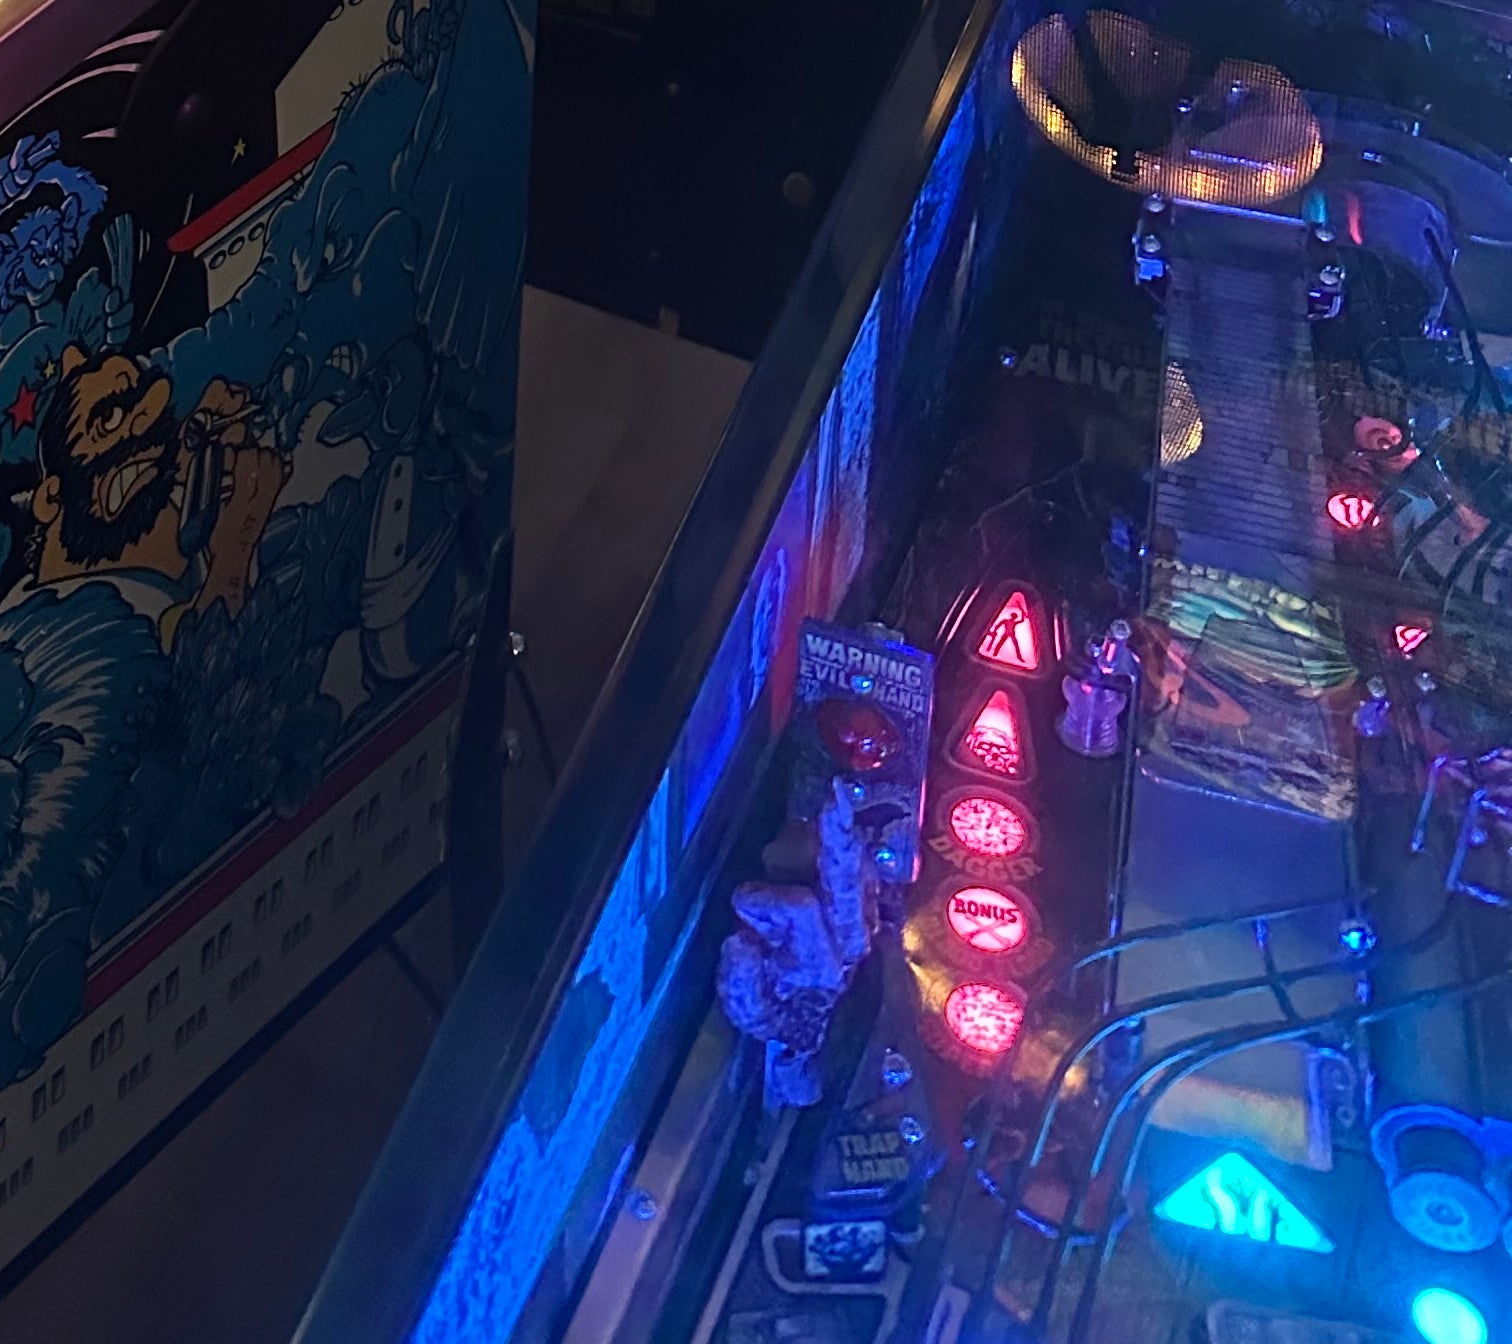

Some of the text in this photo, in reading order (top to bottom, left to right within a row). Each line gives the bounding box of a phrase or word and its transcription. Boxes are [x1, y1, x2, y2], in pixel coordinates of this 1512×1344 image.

[806, 633, 921, 687] WARNING
[800, 658, 925, 713] EVIL HAND
[928, 835, 1043, 880] DAGGER
[953, 895, 1018, 923] BONUS
